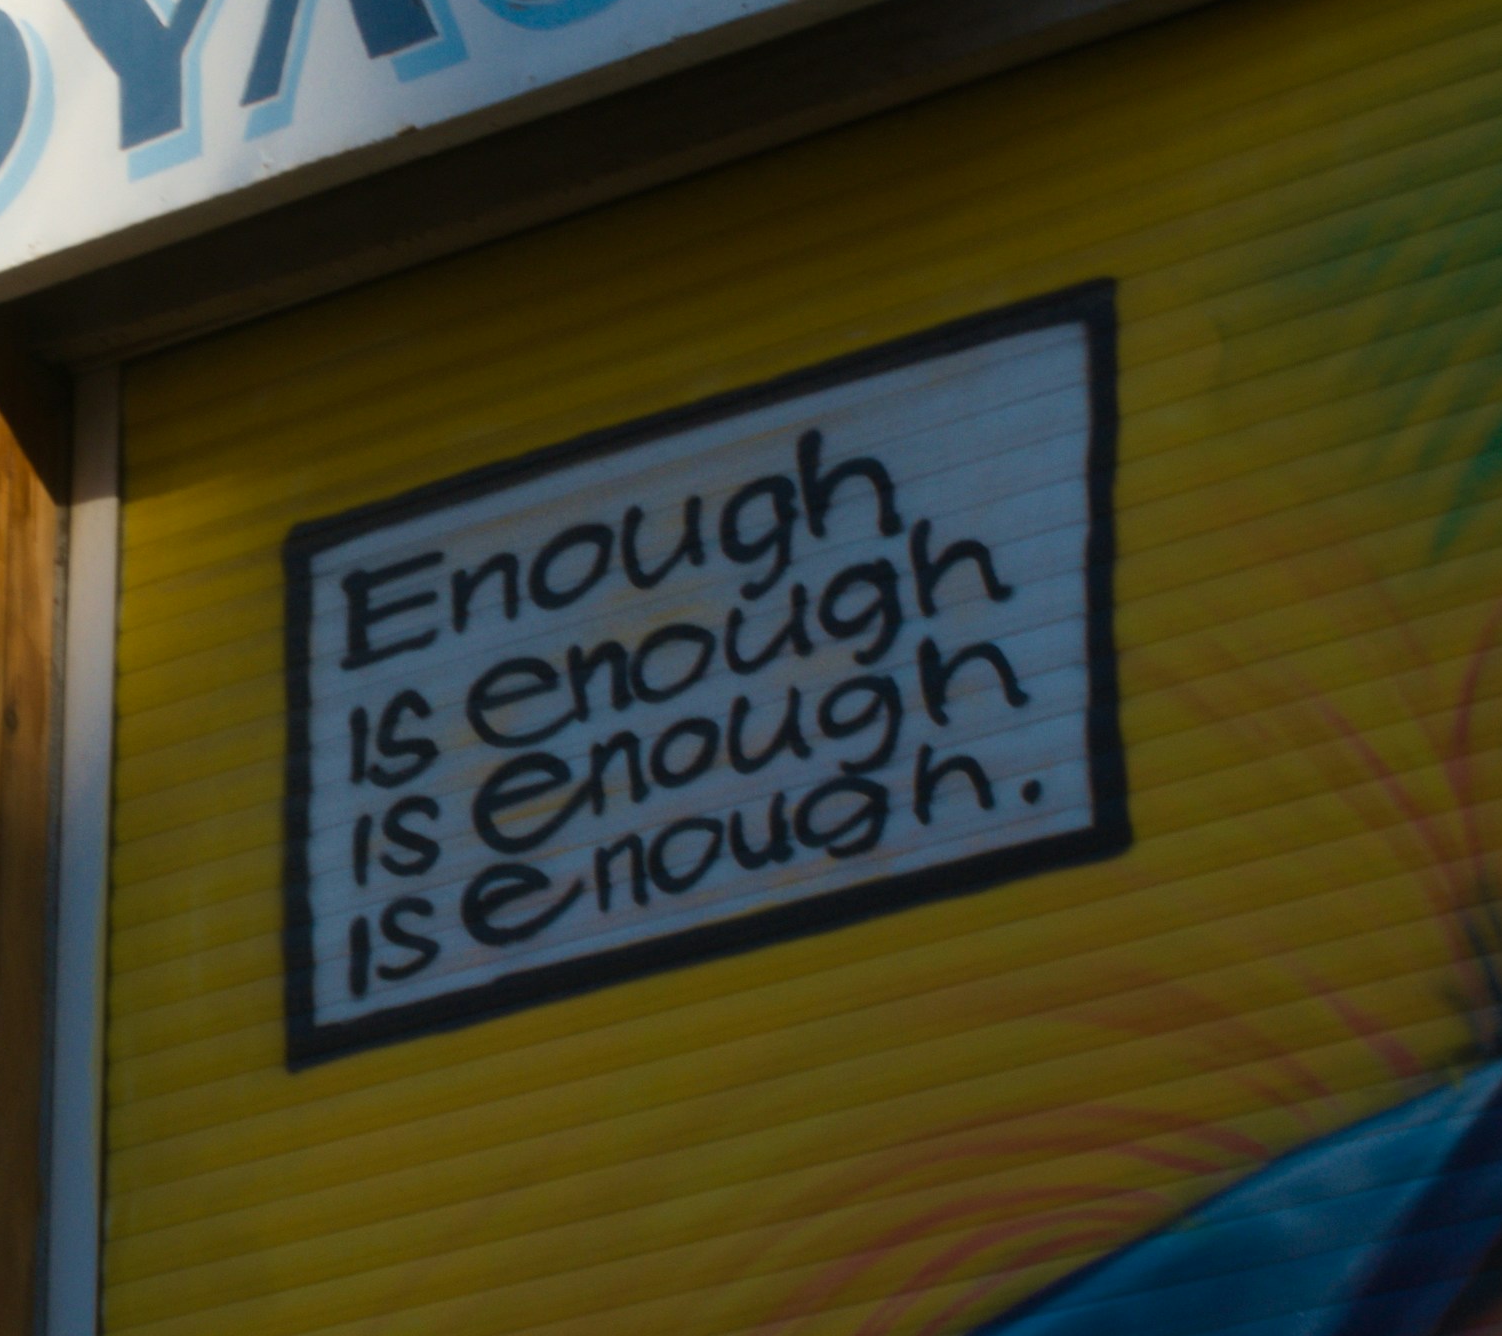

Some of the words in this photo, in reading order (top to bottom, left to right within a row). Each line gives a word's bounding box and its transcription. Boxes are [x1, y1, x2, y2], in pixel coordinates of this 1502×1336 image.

[340, 428, 903, 671] Enough
[464, 518, 1015, 749] enough
[459, 745, 1043, 947] enough.
[471, 635, 1030, 855] enough
